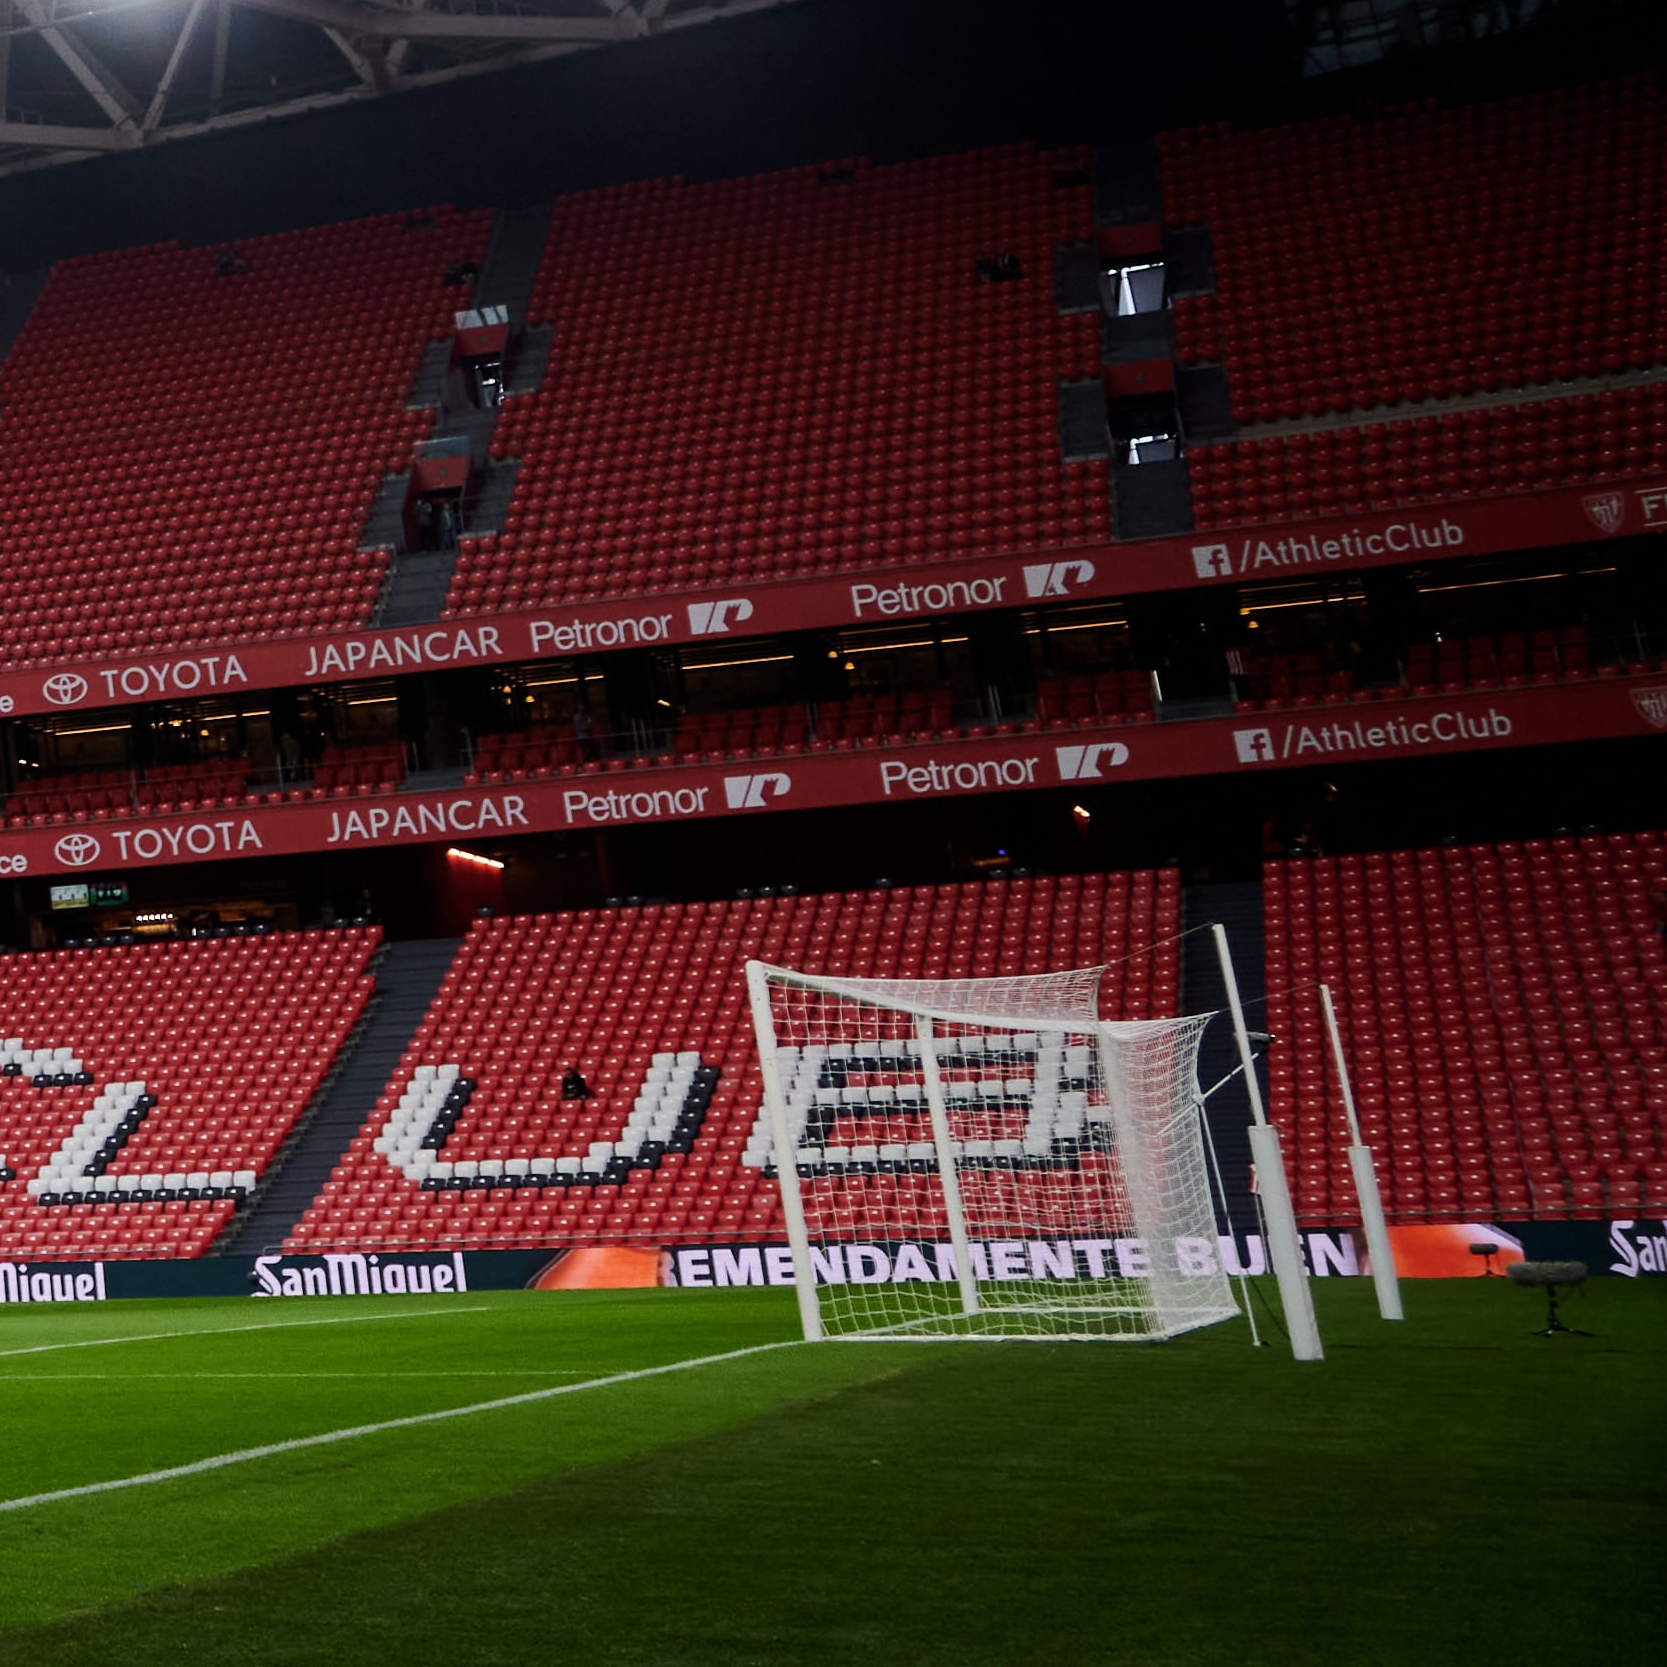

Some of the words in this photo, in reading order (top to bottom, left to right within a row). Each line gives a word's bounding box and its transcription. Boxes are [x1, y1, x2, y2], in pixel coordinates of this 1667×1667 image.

[851, 577, 1006, 617] Petronor
[305, 626, 503, 676] JAPANCAR
[530, 614, 672, 652] Petronor
[100, 655, 247, 697] TOYOTA
[880, 758, 1038, 794] Petronor
[328, 796, 528, 842] JAPANCAR
[563, 787, 708, 823] Petronor
[112, 820, 262, 859] TOYOTA
[1175, 1233, 1359, 1277] BUN
